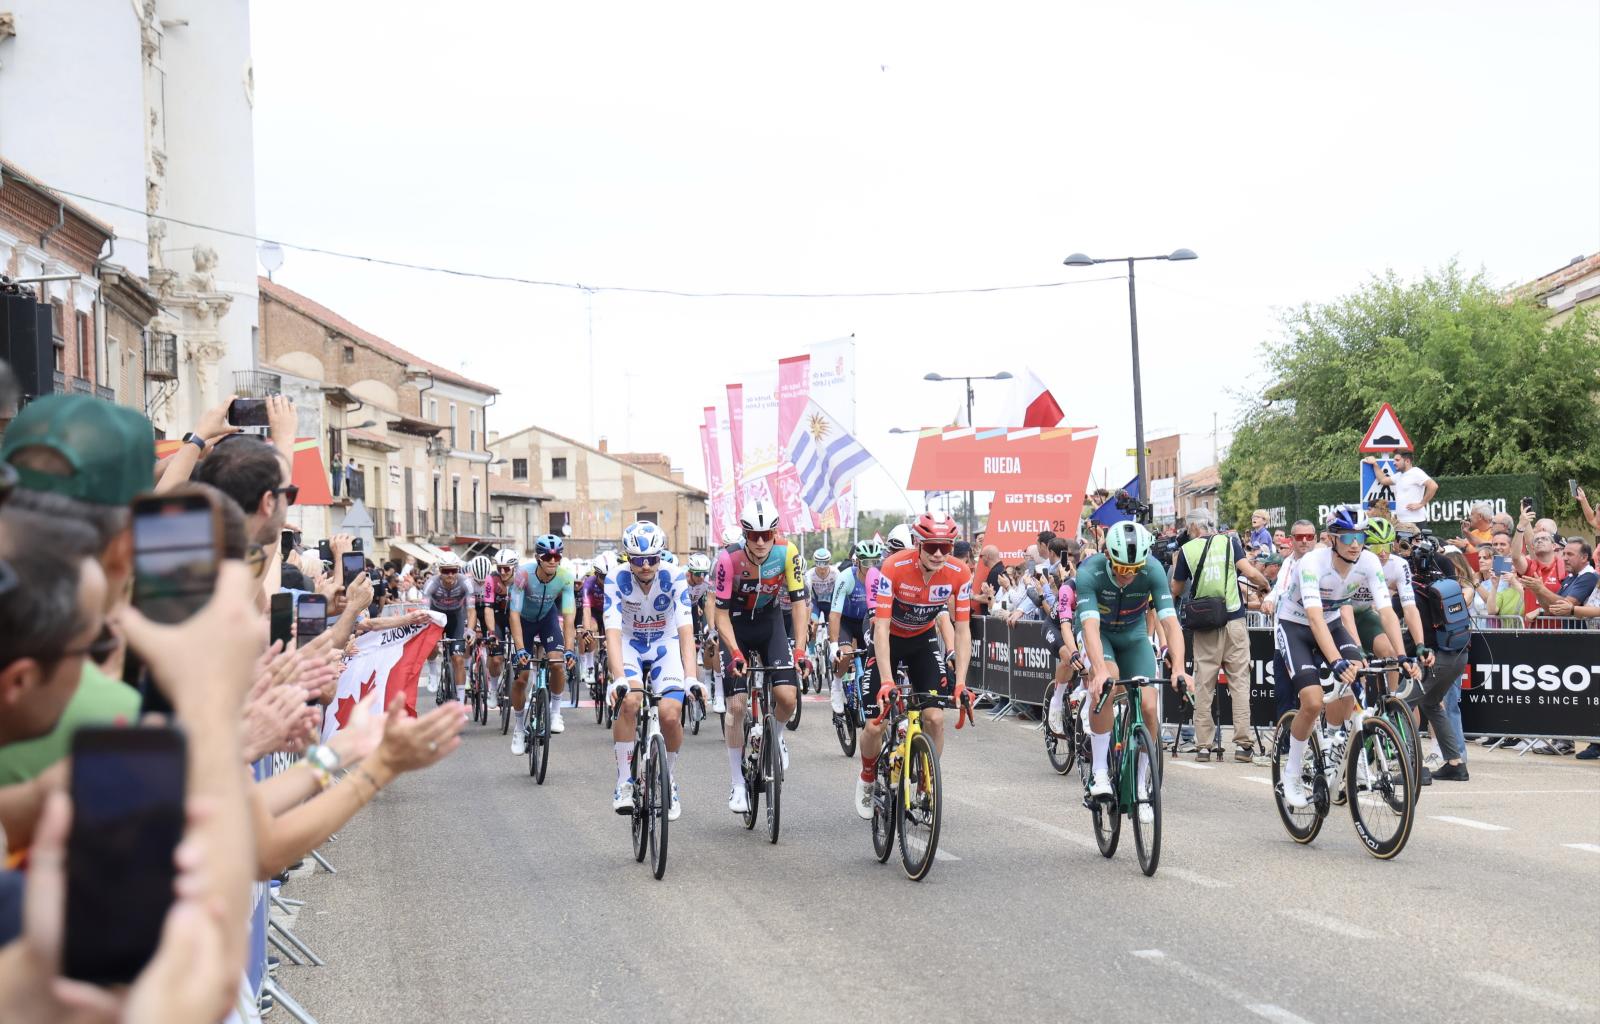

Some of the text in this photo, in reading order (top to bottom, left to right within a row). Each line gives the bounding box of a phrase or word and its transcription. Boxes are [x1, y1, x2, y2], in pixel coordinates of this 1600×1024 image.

[984, 457, 1021, 474] RUEDA
[1024, 494, 1072, 503] TISSOT
[1424, 498, 1506, 522] NCUENO
[998, 520, 1065, 532] LA VUELTA 25
[998, 549, 1024, 558] arrefo
[634, 613, 665, 623] UAE
[996, 642, 1009, 662] TISS
[1024, 646, 1051, 669] TISSOT
[1470, 694, 1531, 704] WATCHES
[1538, 696, 1578, 705] SINCE
